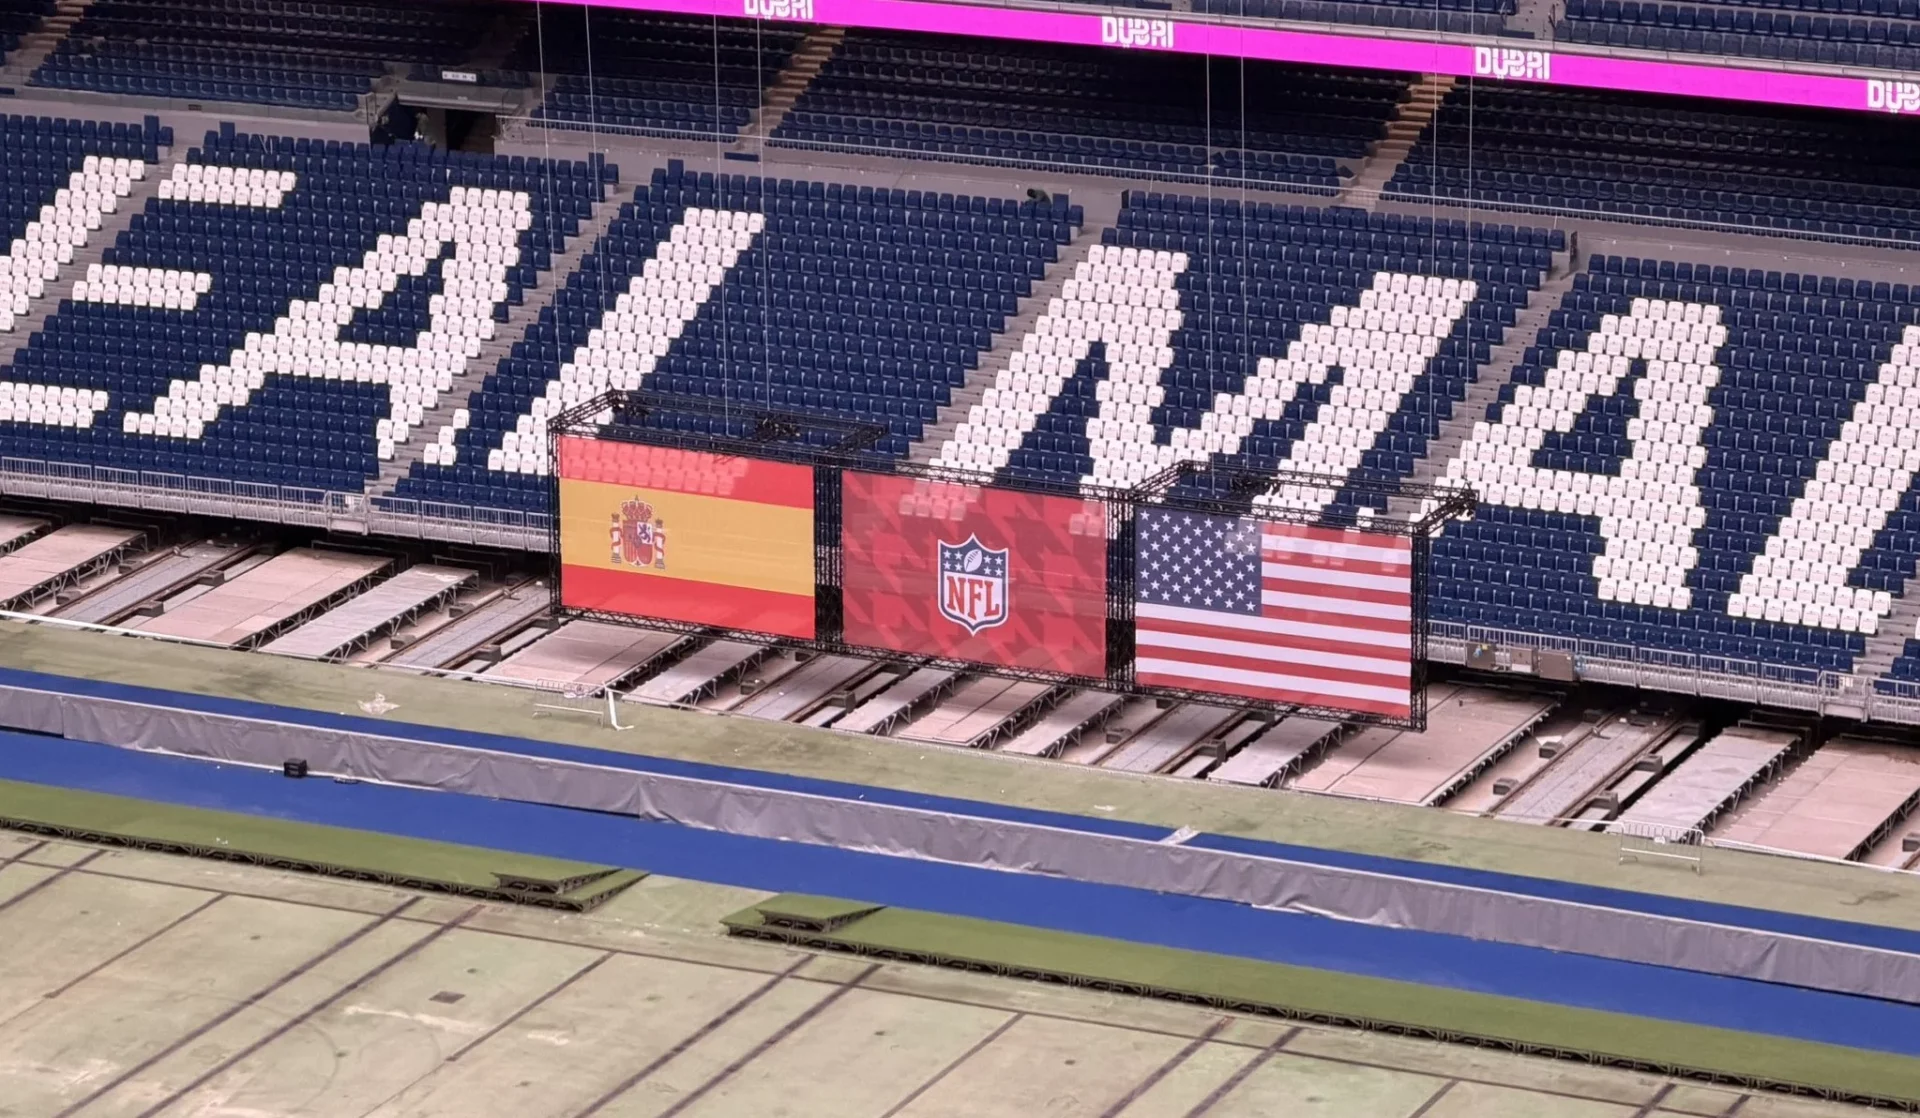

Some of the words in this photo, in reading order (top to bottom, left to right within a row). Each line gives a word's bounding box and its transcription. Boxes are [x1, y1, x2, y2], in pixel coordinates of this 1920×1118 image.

[1102, 16, 1174, 48] DUBAI
[1475, 46, 1550, 80] DUBAI
[946, 575, 1000, 621] NFL
